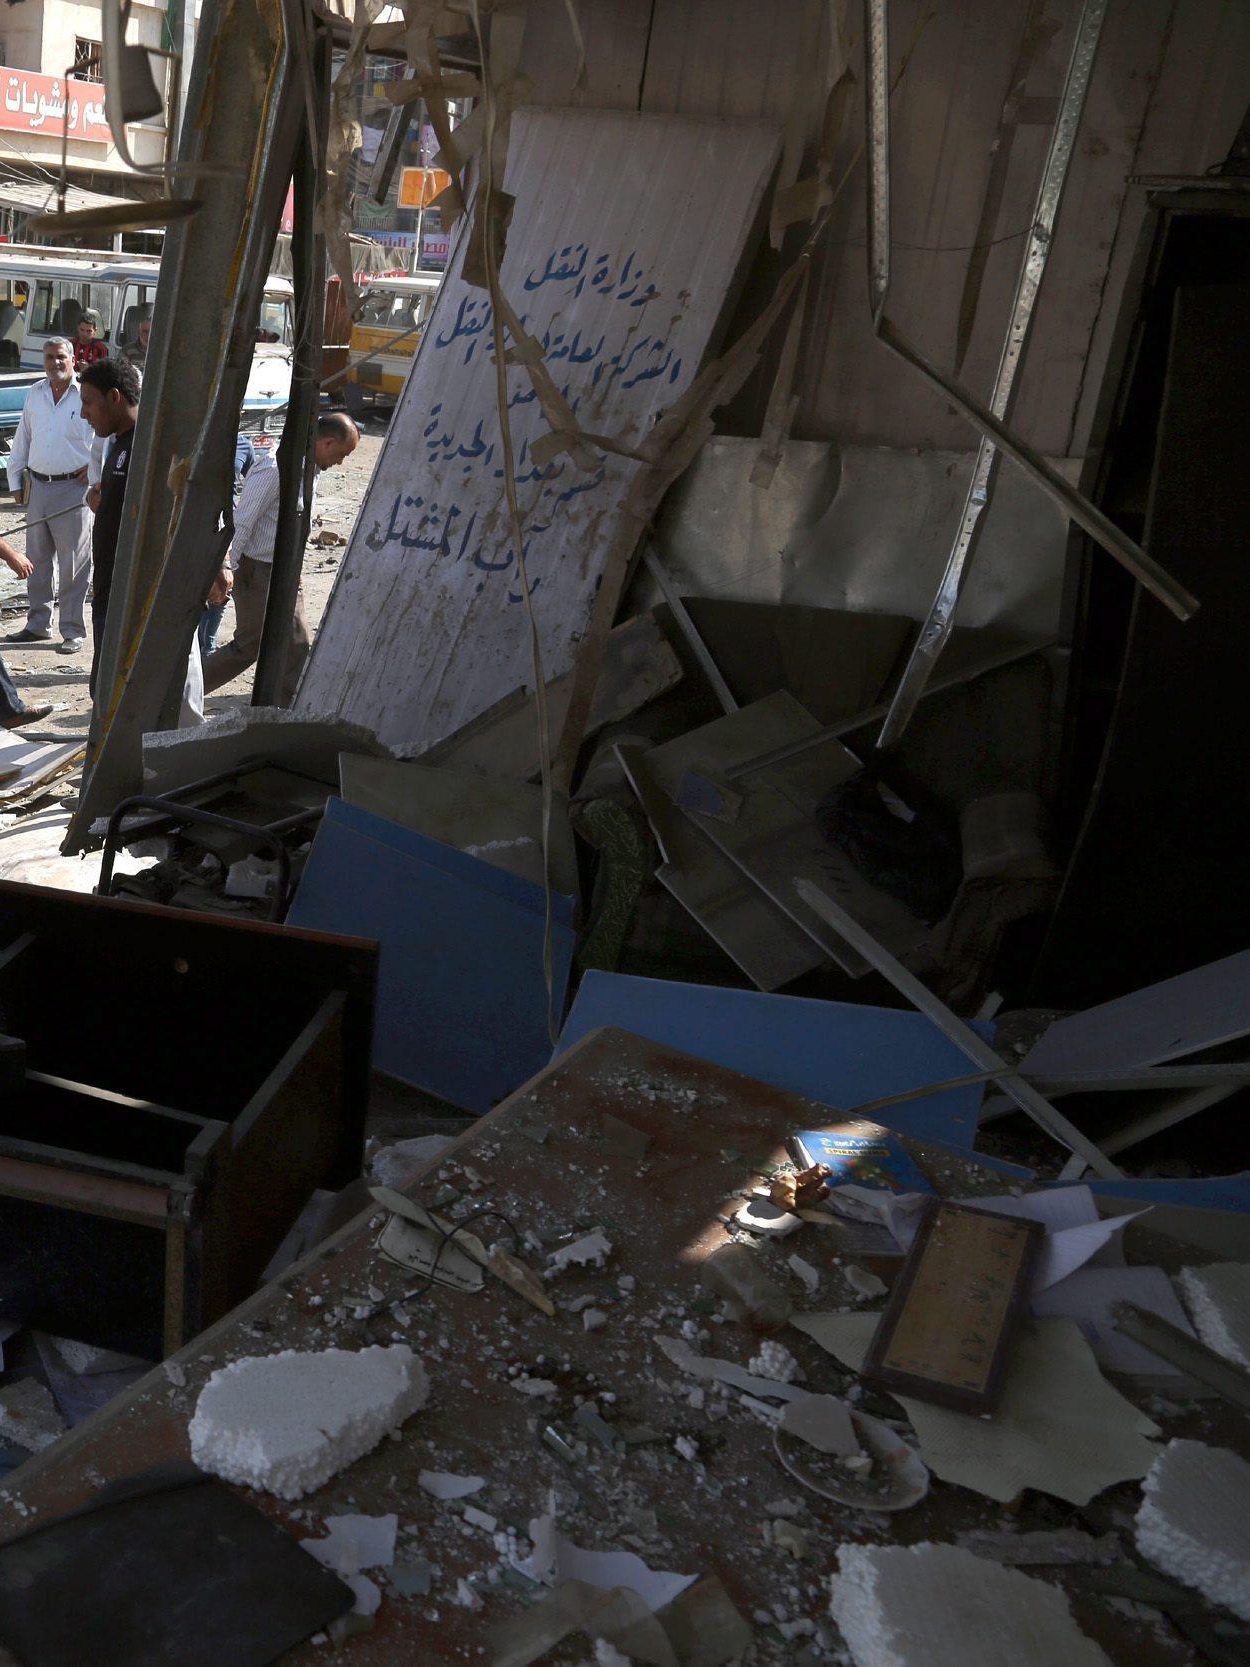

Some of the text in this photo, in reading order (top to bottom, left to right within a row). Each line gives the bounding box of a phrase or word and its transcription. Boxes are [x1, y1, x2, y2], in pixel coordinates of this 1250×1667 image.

[82, 94, 109, 132] عم
[523, 243, 661, 307] وزارة النقل
[435, 295, 493, 365] النقل
[547, 329, 605, 385] العامة
[609, 335, 682, 389] الشركة
[423, 403, 495, 473] الجديدة
[366, 493, 478, 562] المشتل
